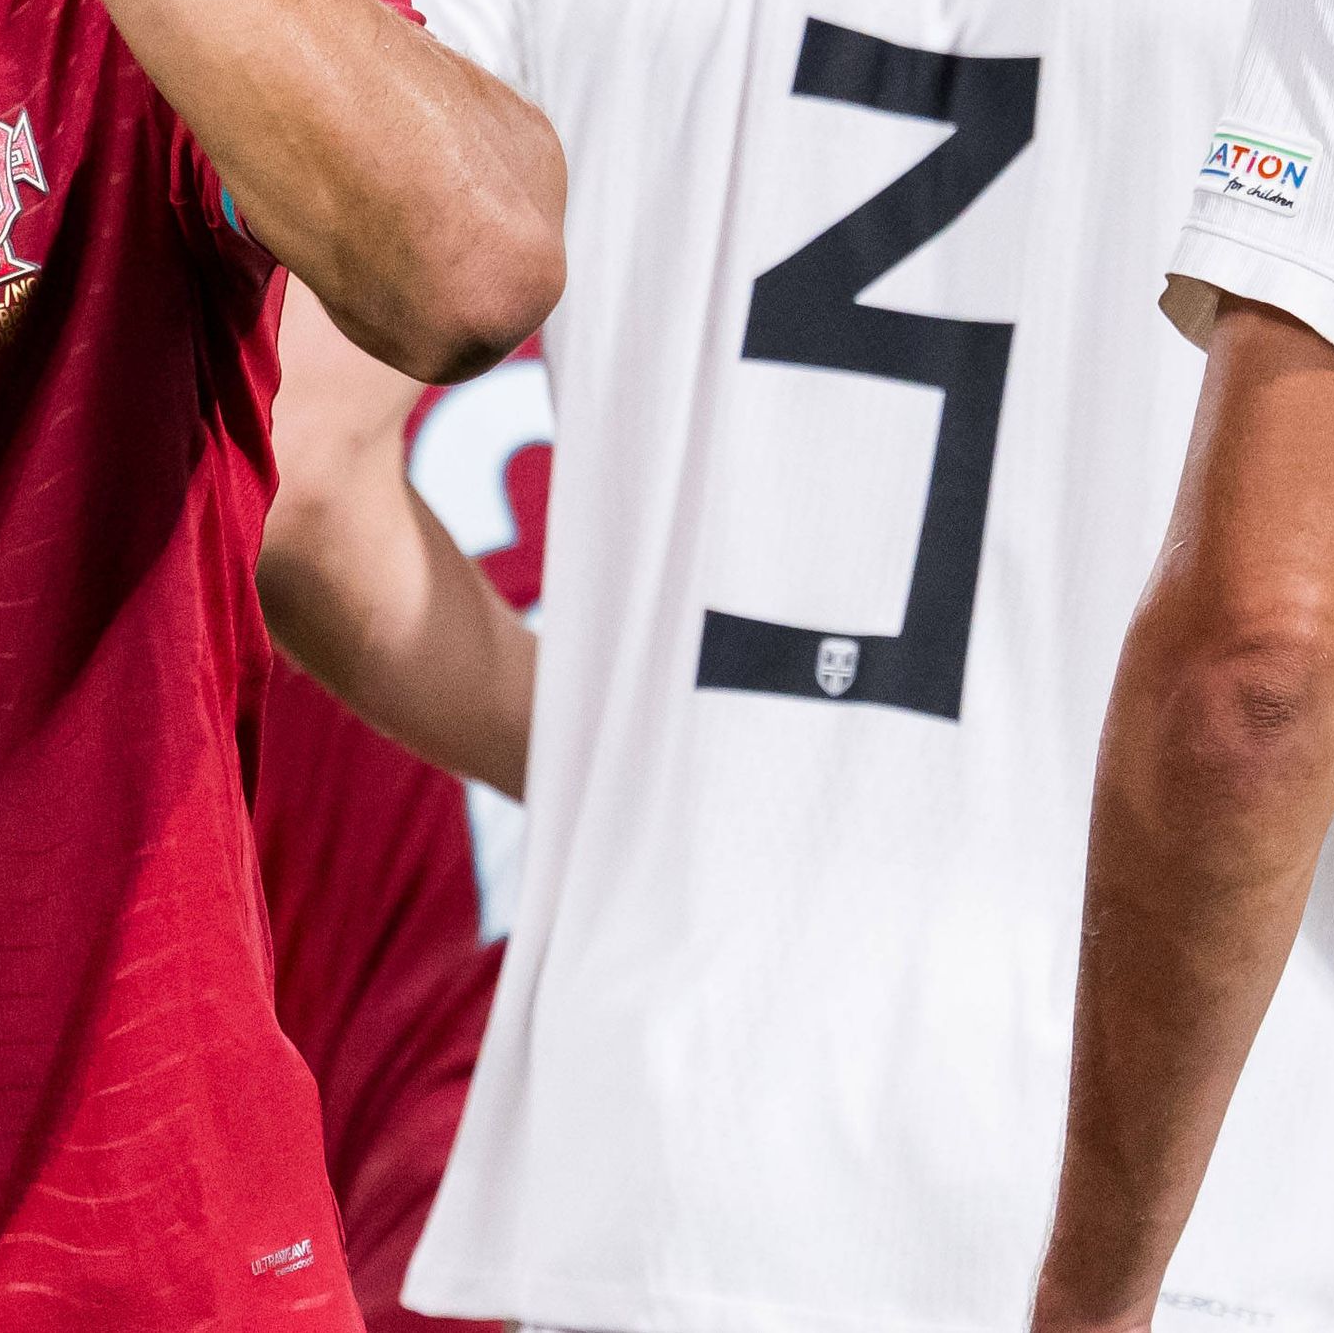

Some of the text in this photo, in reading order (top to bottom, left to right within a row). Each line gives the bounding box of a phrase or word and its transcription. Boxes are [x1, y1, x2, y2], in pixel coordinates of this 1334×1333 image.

[1204, 142, 1309, 189] ATION
[1224, 177, 1294, 209] for children
[696, 16, 1042, 723] 3
